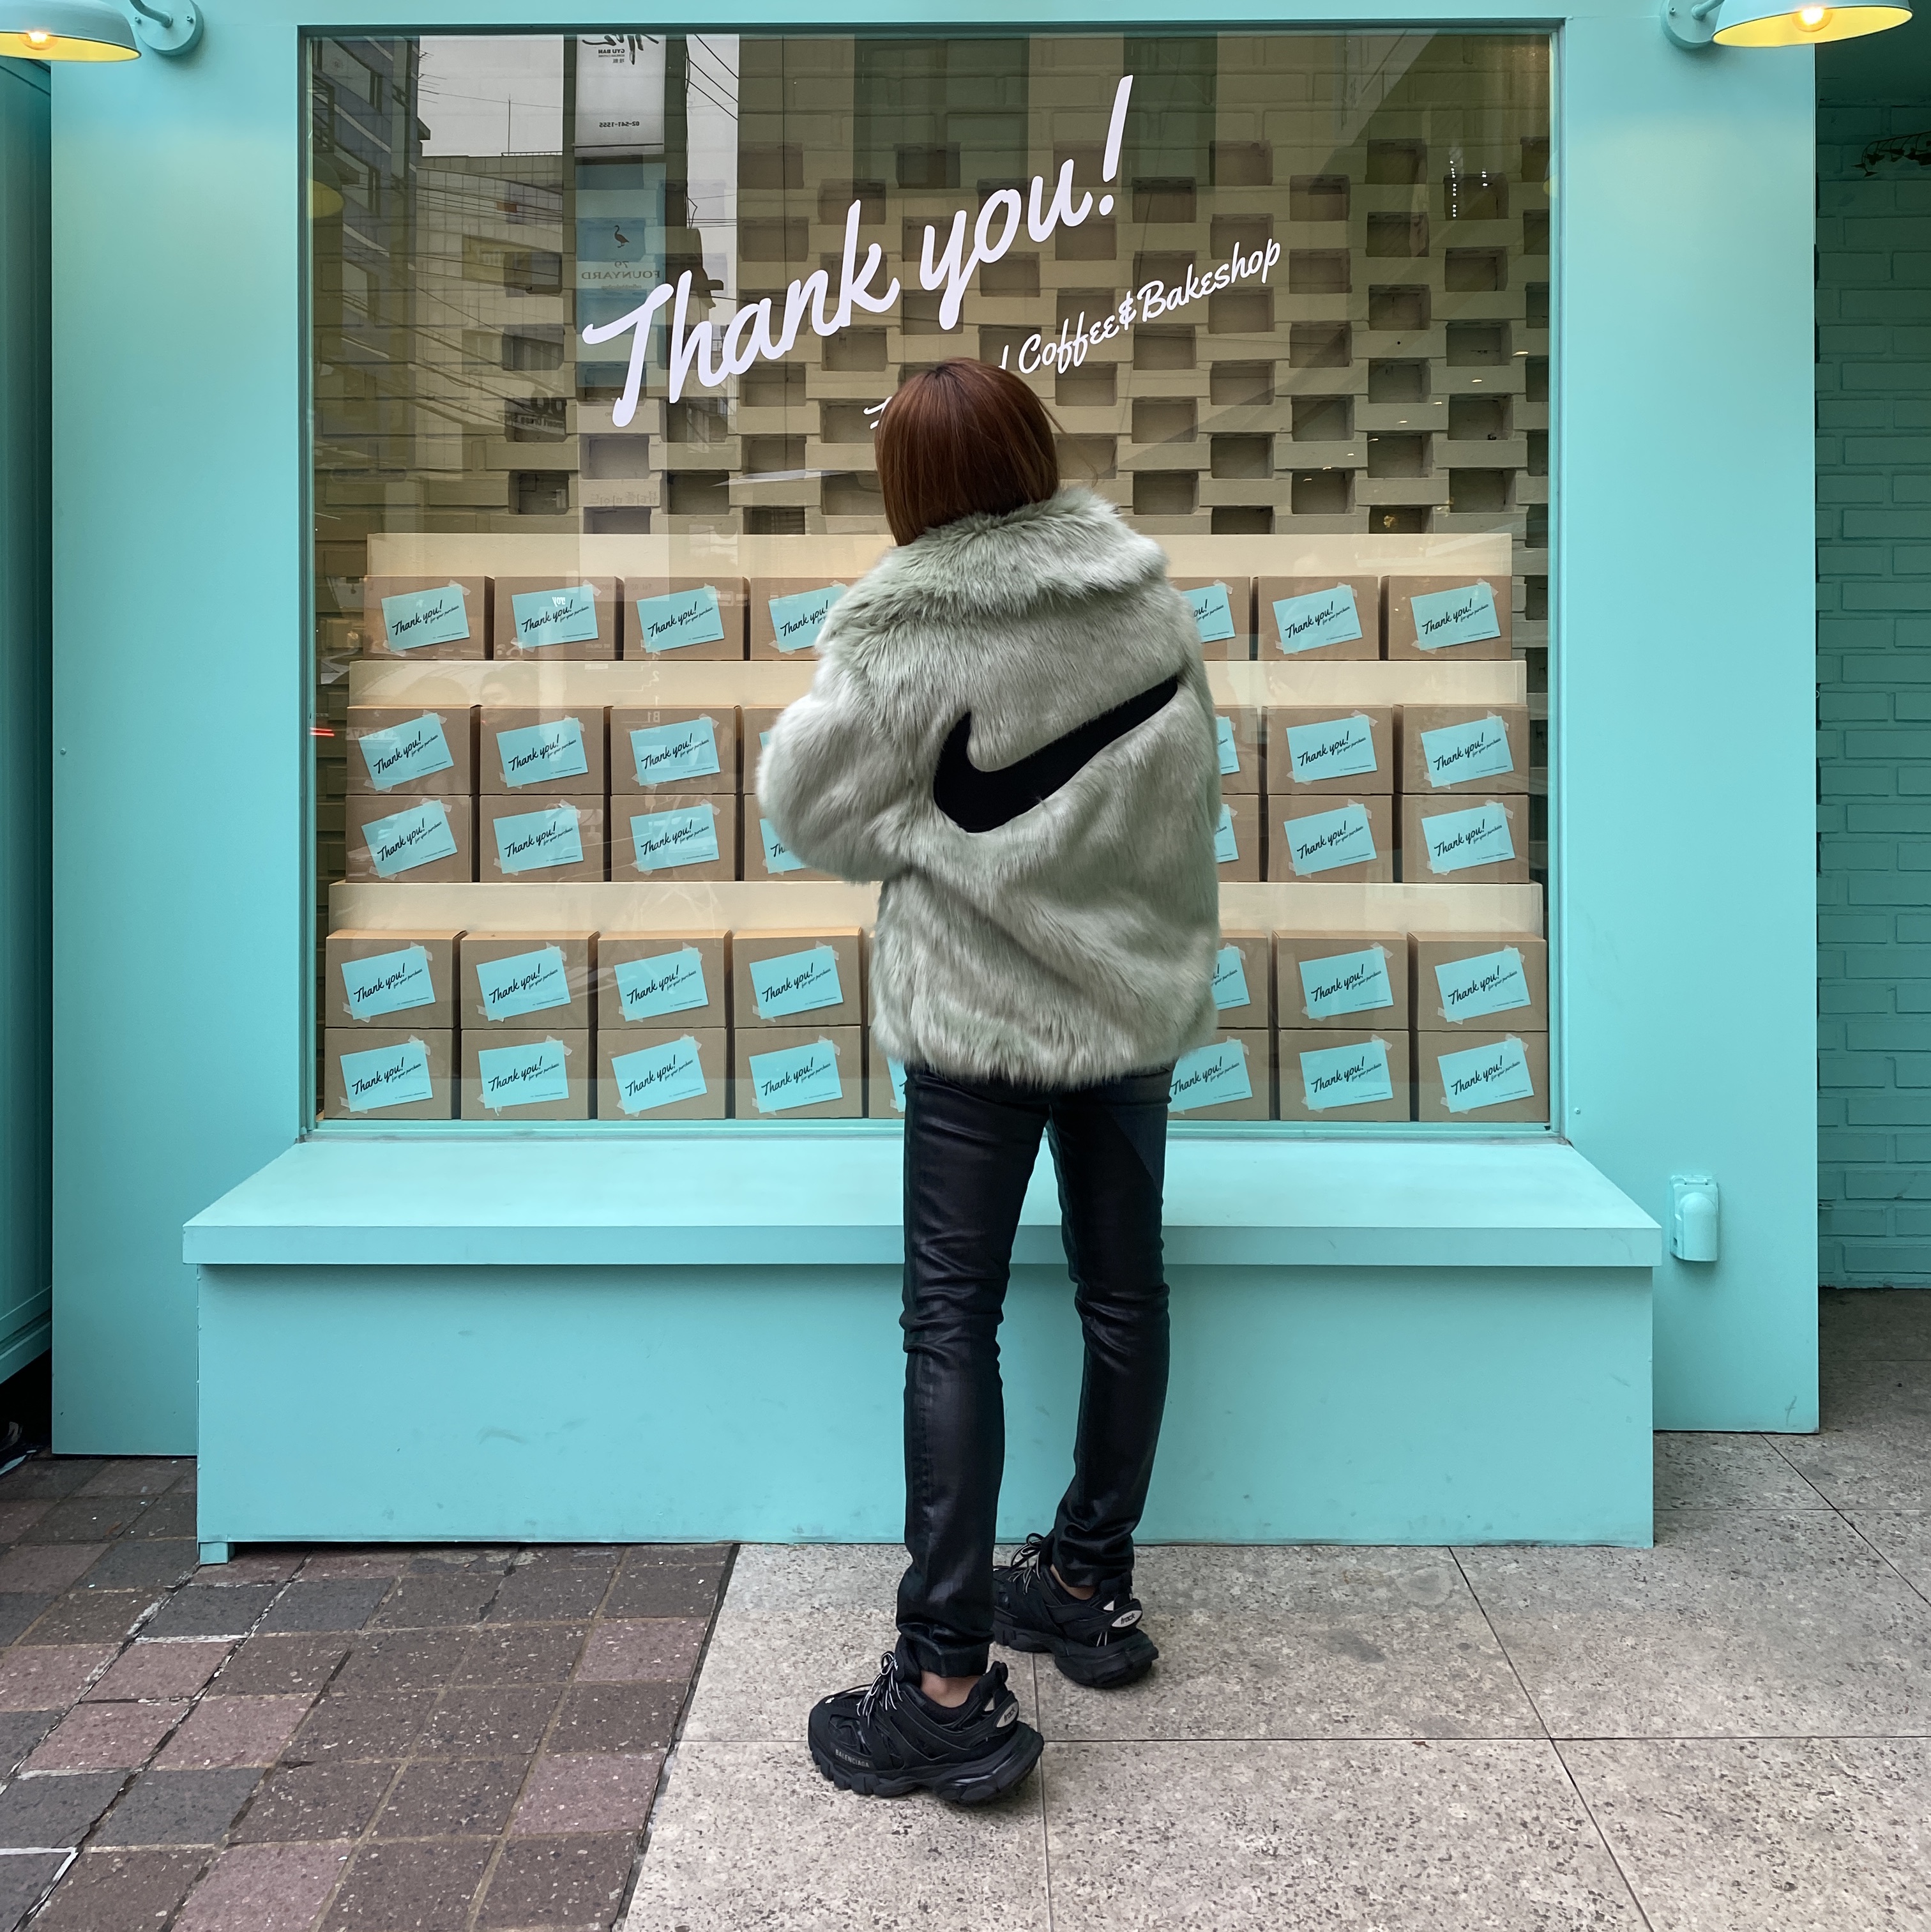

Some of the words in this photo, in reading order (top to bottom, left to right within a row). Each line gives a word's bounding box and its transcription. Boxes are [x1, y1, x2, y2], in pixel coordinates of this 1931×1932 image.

[582, 199, 900, 427] Thank
[920, 75, 1133, 330] you!
[391, 612, 422, 635] Thank
[423, 599, 443, 625] you!
[521, 611, 552, 633] Thank
[552, 599, 573, 623] you!
[647, 614, 677, 637] Thank
[678, 601, 697, 626] you!
[780, 613, 809, 637] Thank
[810, 599, 828, 625] you!
[1193, 598, 1208, 618] ou!
[1284, 614, 1314, 639] Thank
[1315, 600, 1333, 627] you!
[1421, 611, 1452, 635] Thank
[1453, 598, 1472, 623] you!
[373, 747, 403, 774] Thank
[403, 731, 421, 758] you!
[508, 747, 539, 771] Thank
[540, 733, 559, 759] you!
[641, 746, 672, 770] Thank
[672, 733, 692, 758] you!
[1297, 743, 1328, 766] Thank
[1329, 731, 1349, 756] you!
[1433, 747, 1464, 771] Thank
[1464, 732, 1484, 758] you!
[377, 835, 406, 862] Thank
[406, 818, 425, 846] you!
[504, 834, 535, 858] Thank
[536, 821, 556, 847] you!
[640, 832, 671, 855] Thank
[672, 819, 692, 844] you!
[1296, 834, 1327, 859] Thank
[1327, 820, 1346, 847] you!
[1434, 832, 1465, 856] Thank
[1465, 819, 1485, 845] you!
[353, 977, 384, 1003] Thank
[385, 962, 405, 990] you!
[488, 978, 520, 1004] Thank
[520, 963, 540, 991] you!
[626, 979, 658, 1005] Thank
[658, 964, 679, 992] you!
[762, 977, 793, 1003] Thank
[794, 962, 814, 990] you!
[1311, 977, 1343, 1002] Thank
[1344, 964, 1364, 991] you!
[1448, 980, 1479, 1005] Thank
[1480, 965, 1499, 992] you!
[351, 1070, 383, 1095] Thank
[384, 1056, 404, 1083] you!
[488, 1068, 520, 1092] Thank
[520, 1056, 542, 1081] you!
[625, 1070, 656, 1097] Thank
[656, 1054, 676, 1083] you!
[761, 1071, 792, 1096] Thank
[793, 1057, 814, 1084] you!
[1170, 1070, 1202, 1095] Thank
[1202, 1056, 1222, 1082] you!
[1311, 1069, 1343, 1093] Thank
[1344, 1056, 1365, 1083] you!
[1451, 1070, 1482, 1095] Thank
[1483, 1054, 1503, 1083] you!
[835, 1749, 870, 1768] BALENCIAGA
